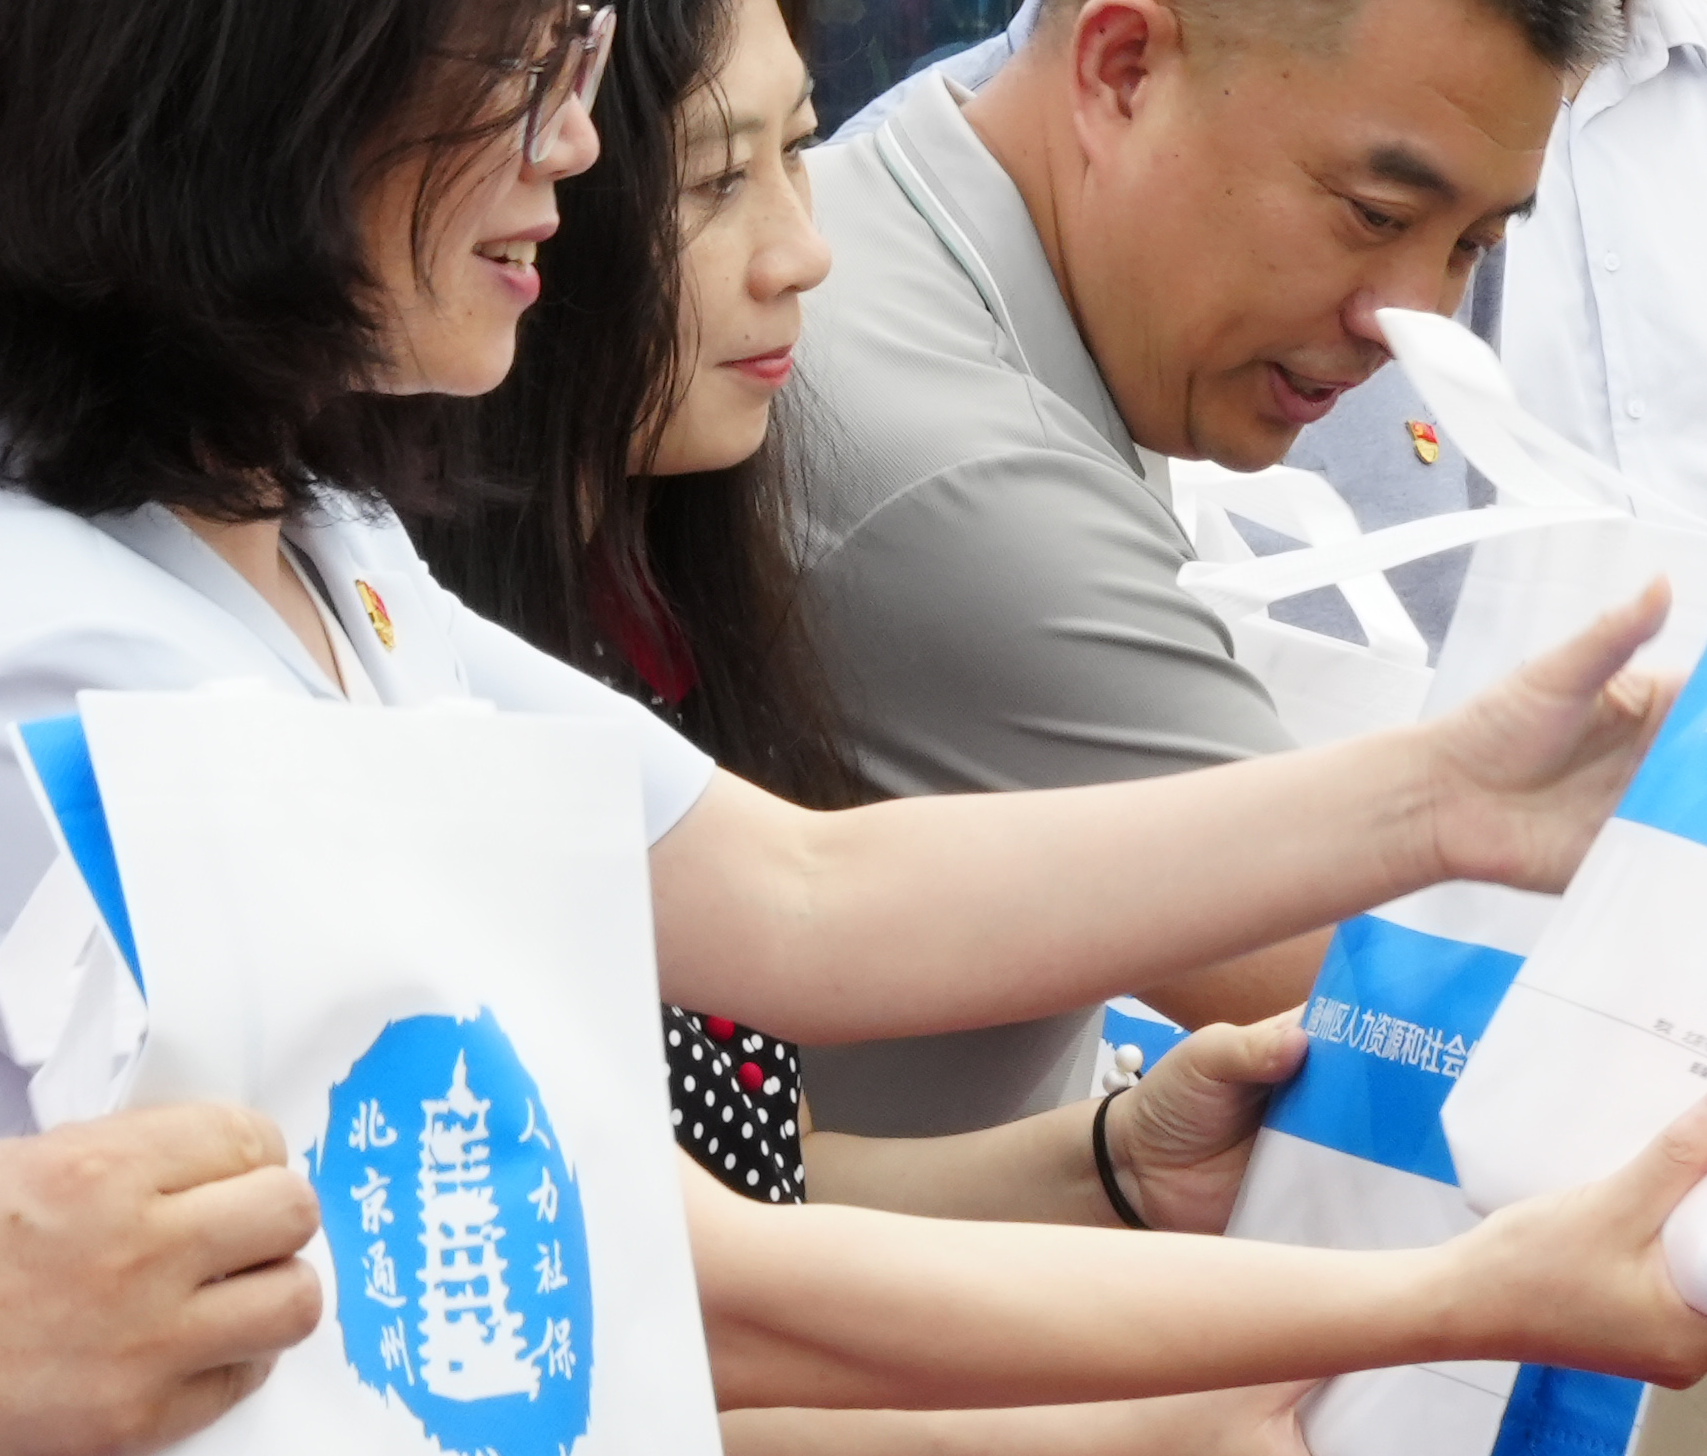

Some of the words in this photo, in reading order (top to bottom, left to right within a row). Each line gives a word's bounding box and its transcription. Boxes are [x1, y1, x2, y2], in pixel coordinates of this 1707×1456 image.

[348, 1097, 416, 1387] 北京通州
[518, 1097, 578, 1381] 人力社保
